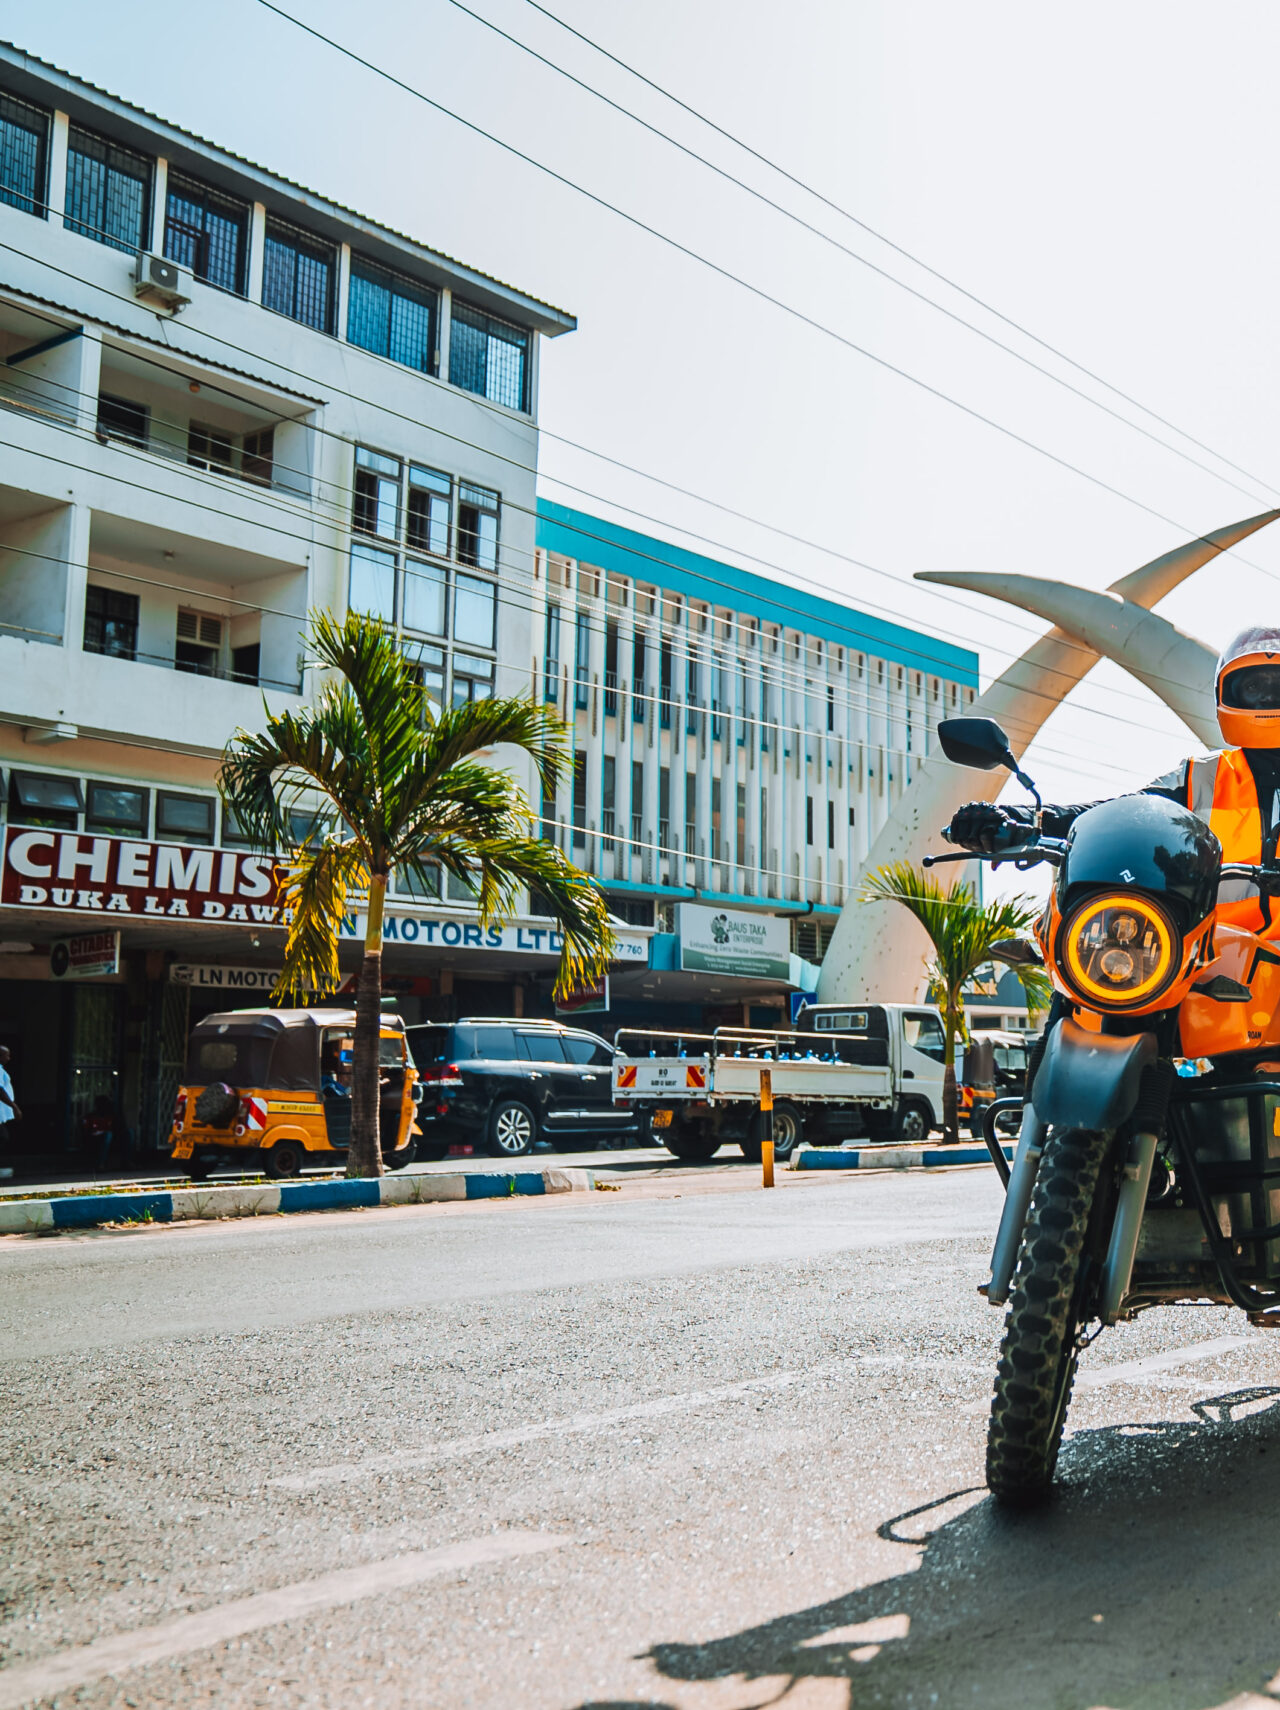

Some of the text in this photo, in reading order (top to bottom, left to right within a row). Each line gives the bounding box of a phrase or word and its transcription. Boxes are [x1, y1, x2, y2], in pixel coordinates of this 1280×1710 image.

[20, 885, 294, 924] DUKA LA DAWA
[383, 916, 503, 948] MOTORS
[517, 928, 565, 952] LTD
[728, 921, 767, 936] BAUS TAKA
[627, 944, 643, 955] 760
[199, 969, 223, 984] LN
